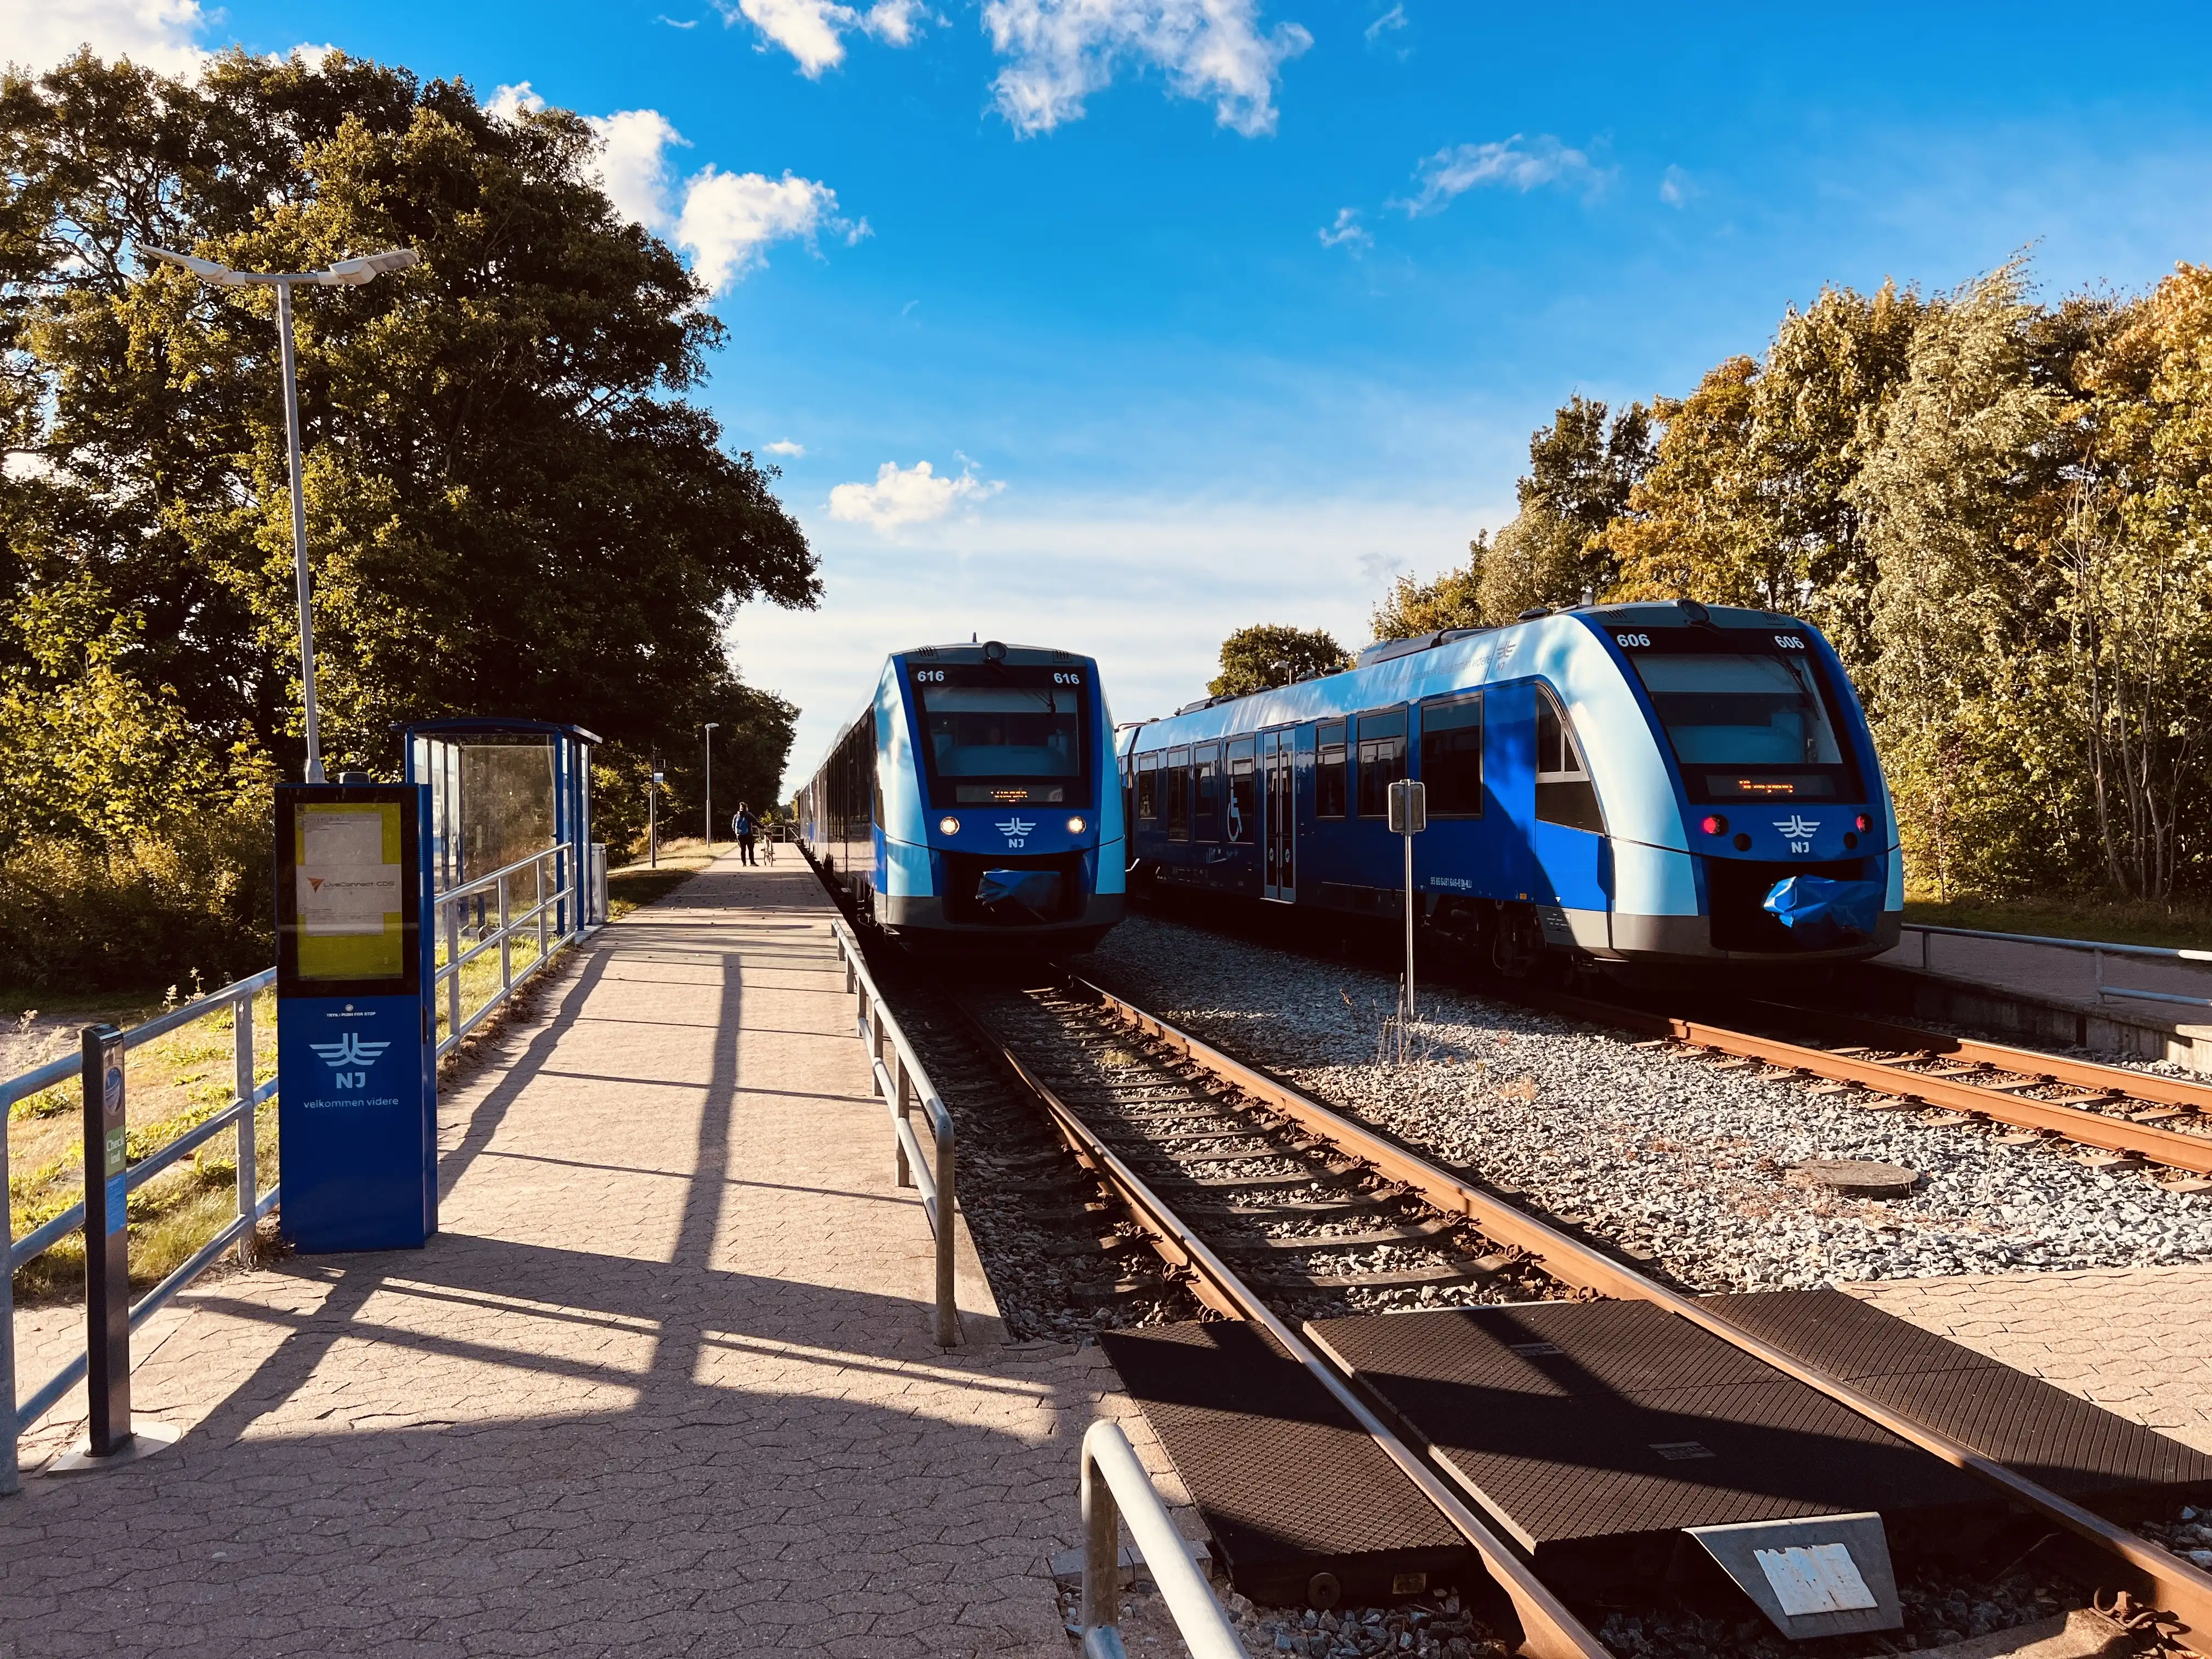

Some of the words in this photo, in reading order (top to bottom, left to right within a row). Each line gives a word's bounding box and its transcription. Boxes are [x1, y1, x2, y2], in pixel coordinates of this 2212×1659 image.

[1617, 634, 1650, 647] 606
[1775, 635, 1804, 649] 606
[1472, 654, 1491, 668] videre
[1496, 662, 1505, 672] NJ
[917, 670, 944, 682] 616
[1054, 673, 1080, 685] 616
[1008, 839, 1024, 848] NJ
[1791, 842, 1809, 853] NJ
[336, 1072, 366, 1088] NJ
[303, 1099, 364, 1108] velkommen
[366, 1097, 399, 1106] videre
[106, 1135, 126, 1152] Check
[110, 1150, 121, 1164] ind
